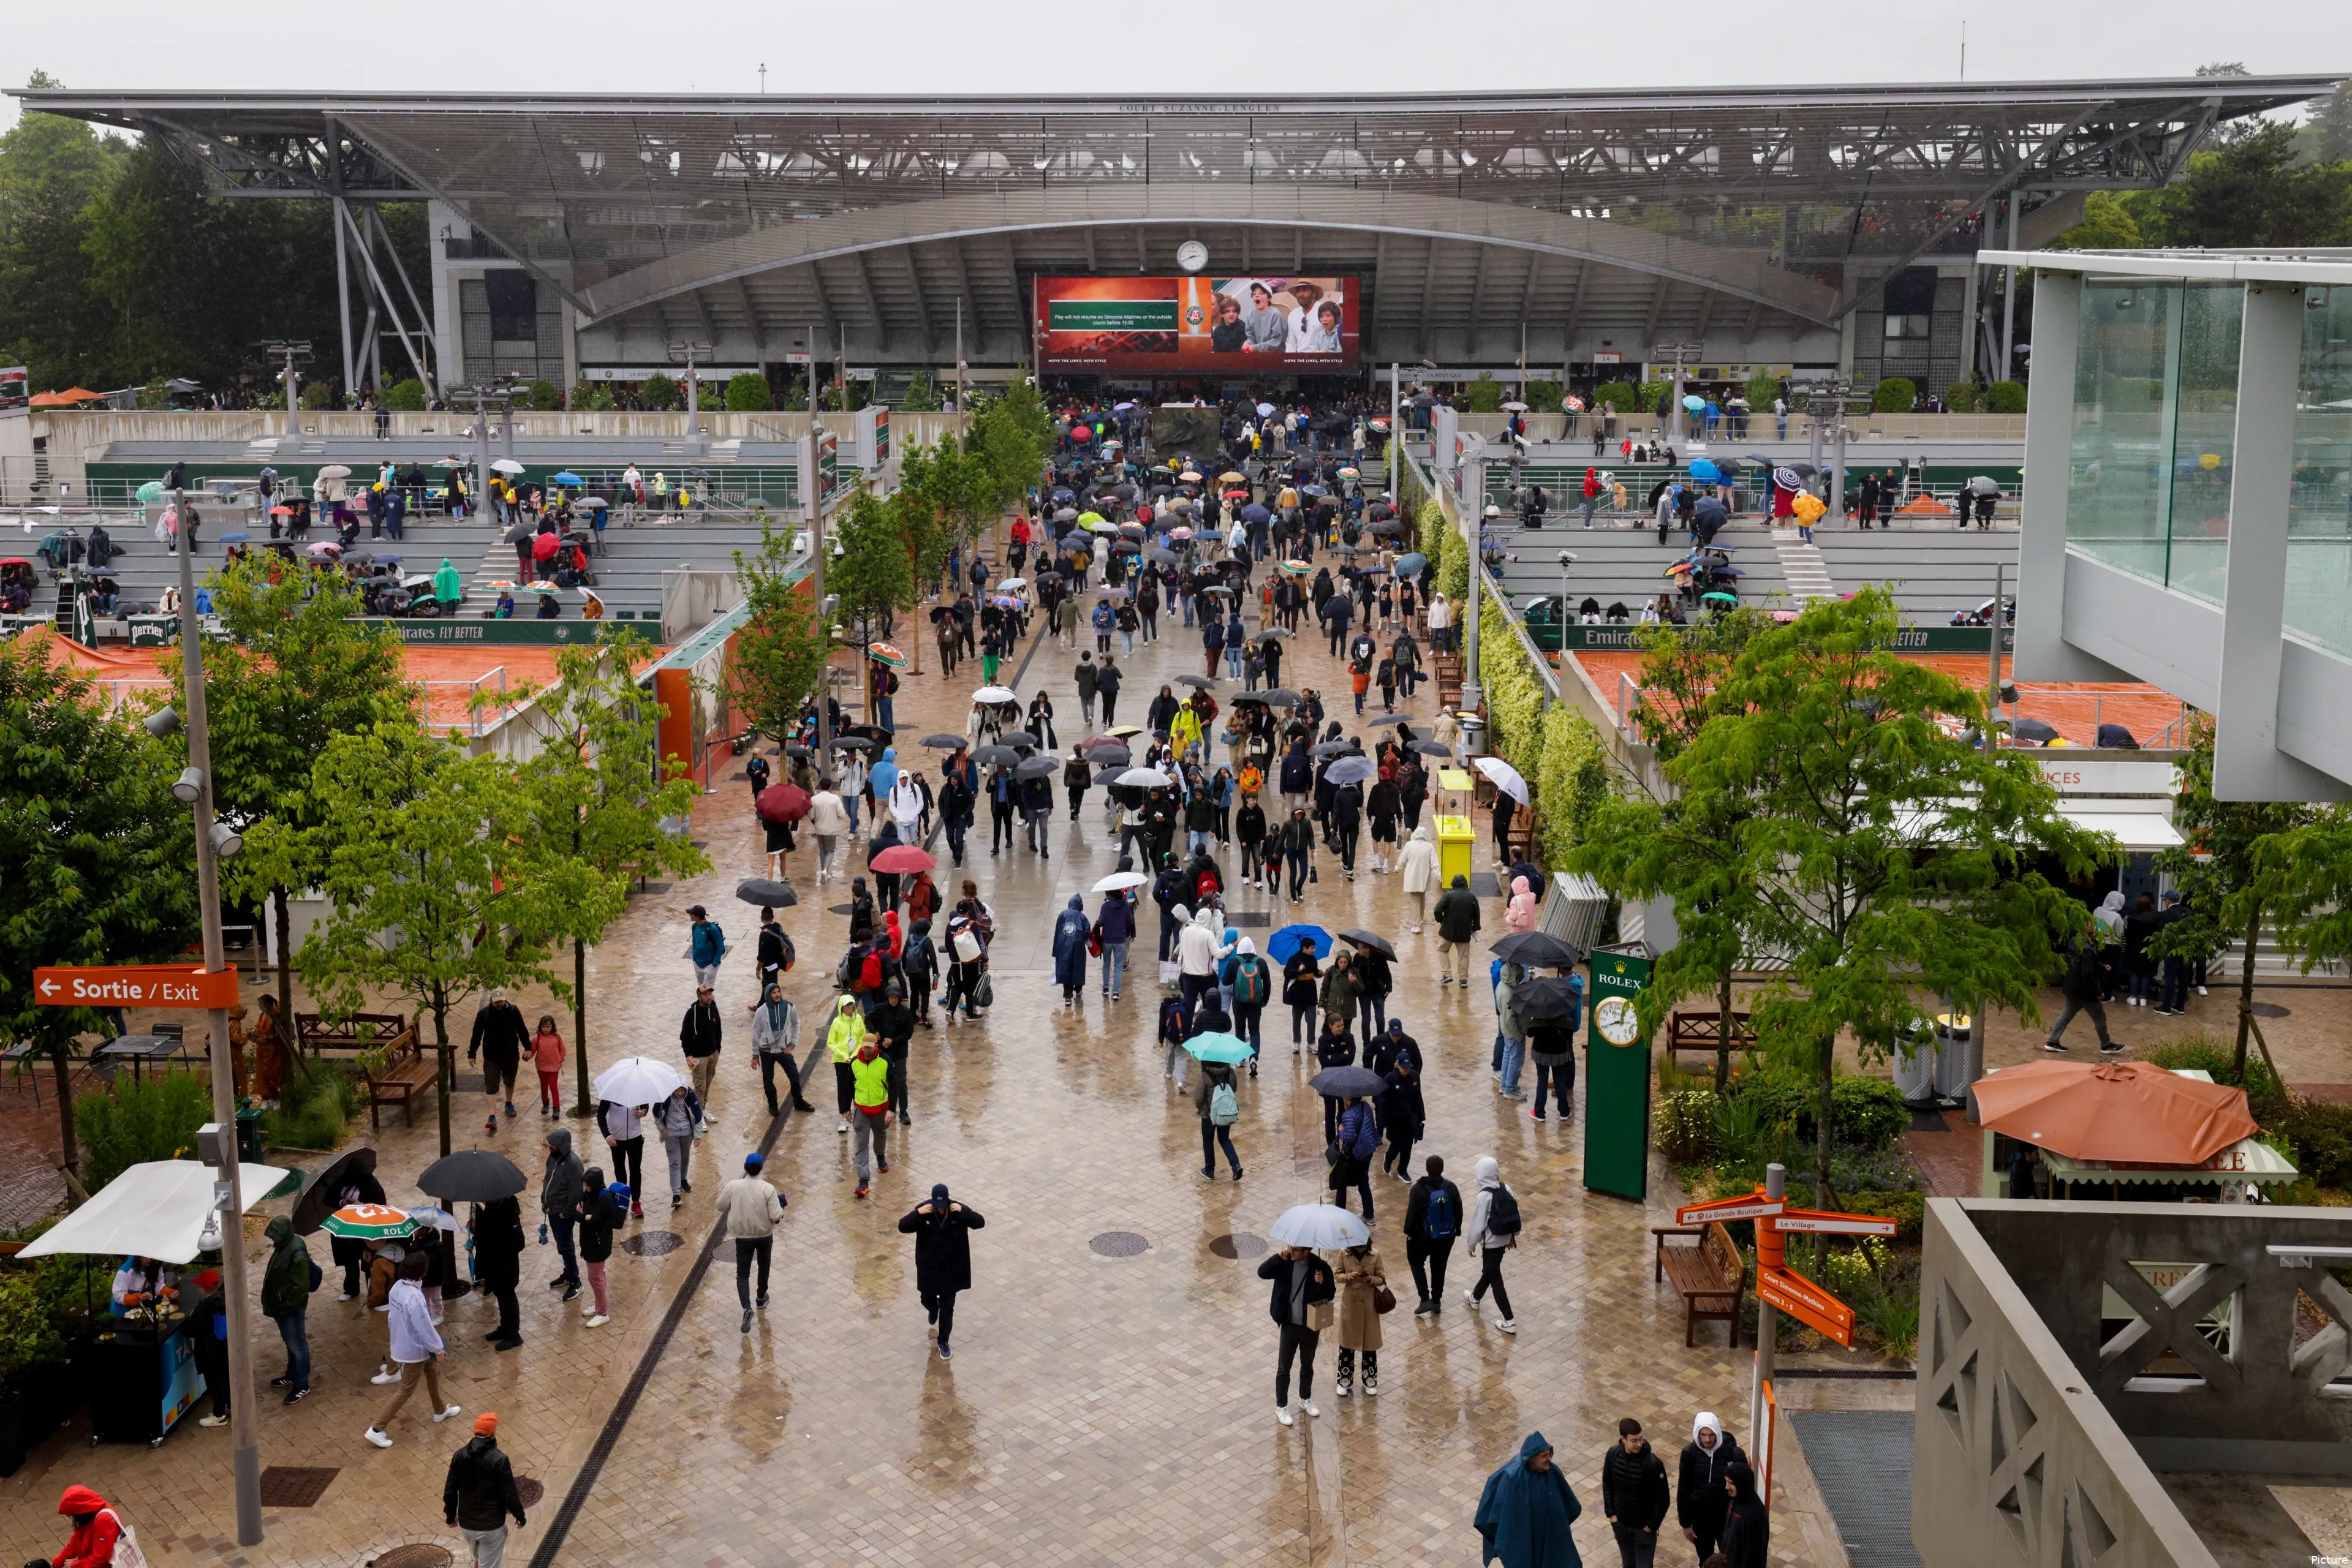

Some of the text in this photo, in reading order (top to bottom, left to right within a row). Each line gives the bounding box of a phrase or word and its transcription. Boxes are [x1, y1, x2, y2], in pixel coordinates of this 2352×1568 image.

[722, 492, 746, 502] BETTER
[131, 623, 164, 645] perrier
[440, 626, 453, 639] FLY
[455, 626, 483, 639] BETTER
[1598, 973, 1642, 989] ROLEX
[72, 979, 200, 1001] Sortie / Exit
[1737, 1208, 1763, 1216] Boutique
[326, 1220, 339, 1231] PARIS
[1791, 1221, 1815, 1230] Village
[1763, 1289, 1780, 1303] Courts
[1764, 1273, 1825, 1311] Court Simonne-Mathieu
